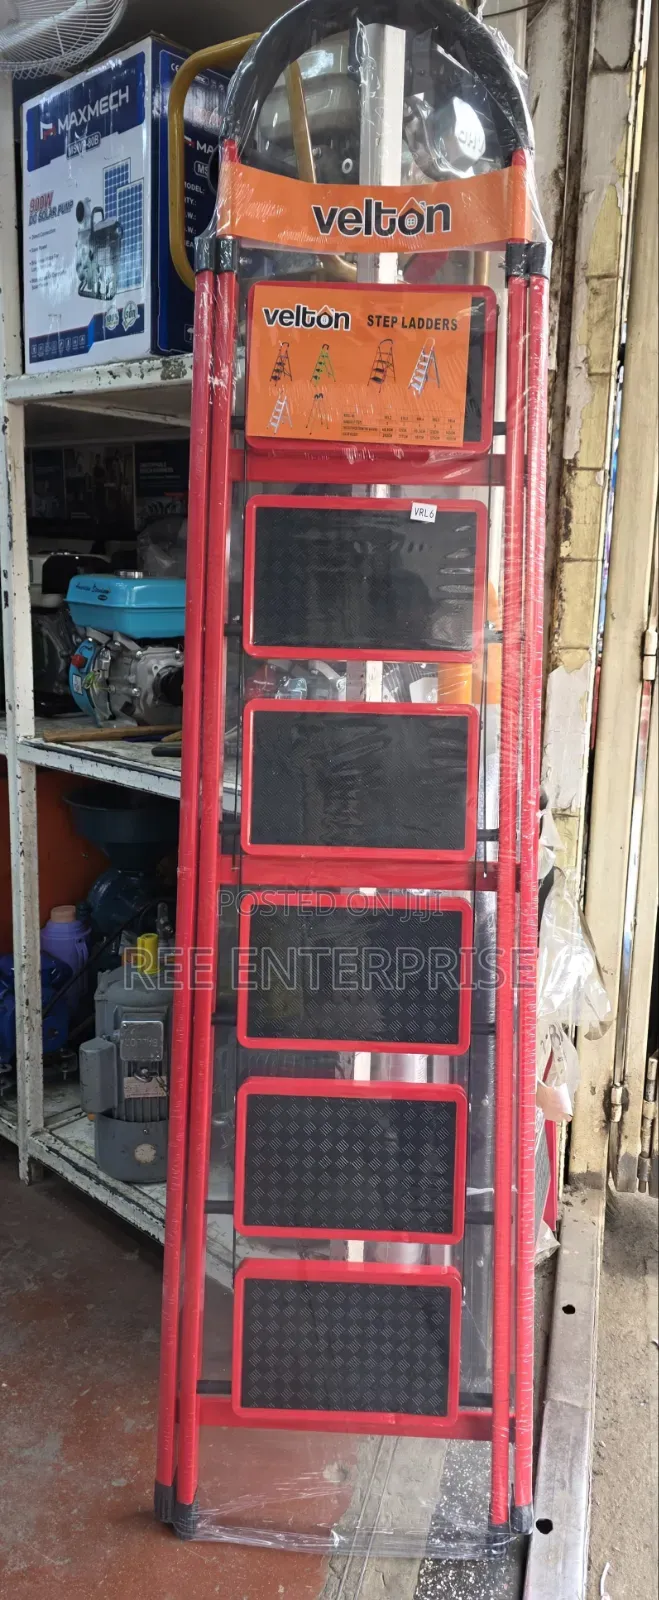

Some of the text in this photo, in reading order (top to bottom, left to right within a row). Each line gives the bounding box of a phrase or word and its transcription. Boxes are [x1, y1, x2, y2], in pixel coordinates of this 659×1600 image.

[57, 85, 129, 135] MAXMECH
[38, 205, 57, 223] SOLAR
[58, 199, 73, 217] PUMP
[311, 197, 451, 237] velton
[262, 303, 458, 331] velton STEP LADDERS
[414, 507, 435, 519] VRL6
